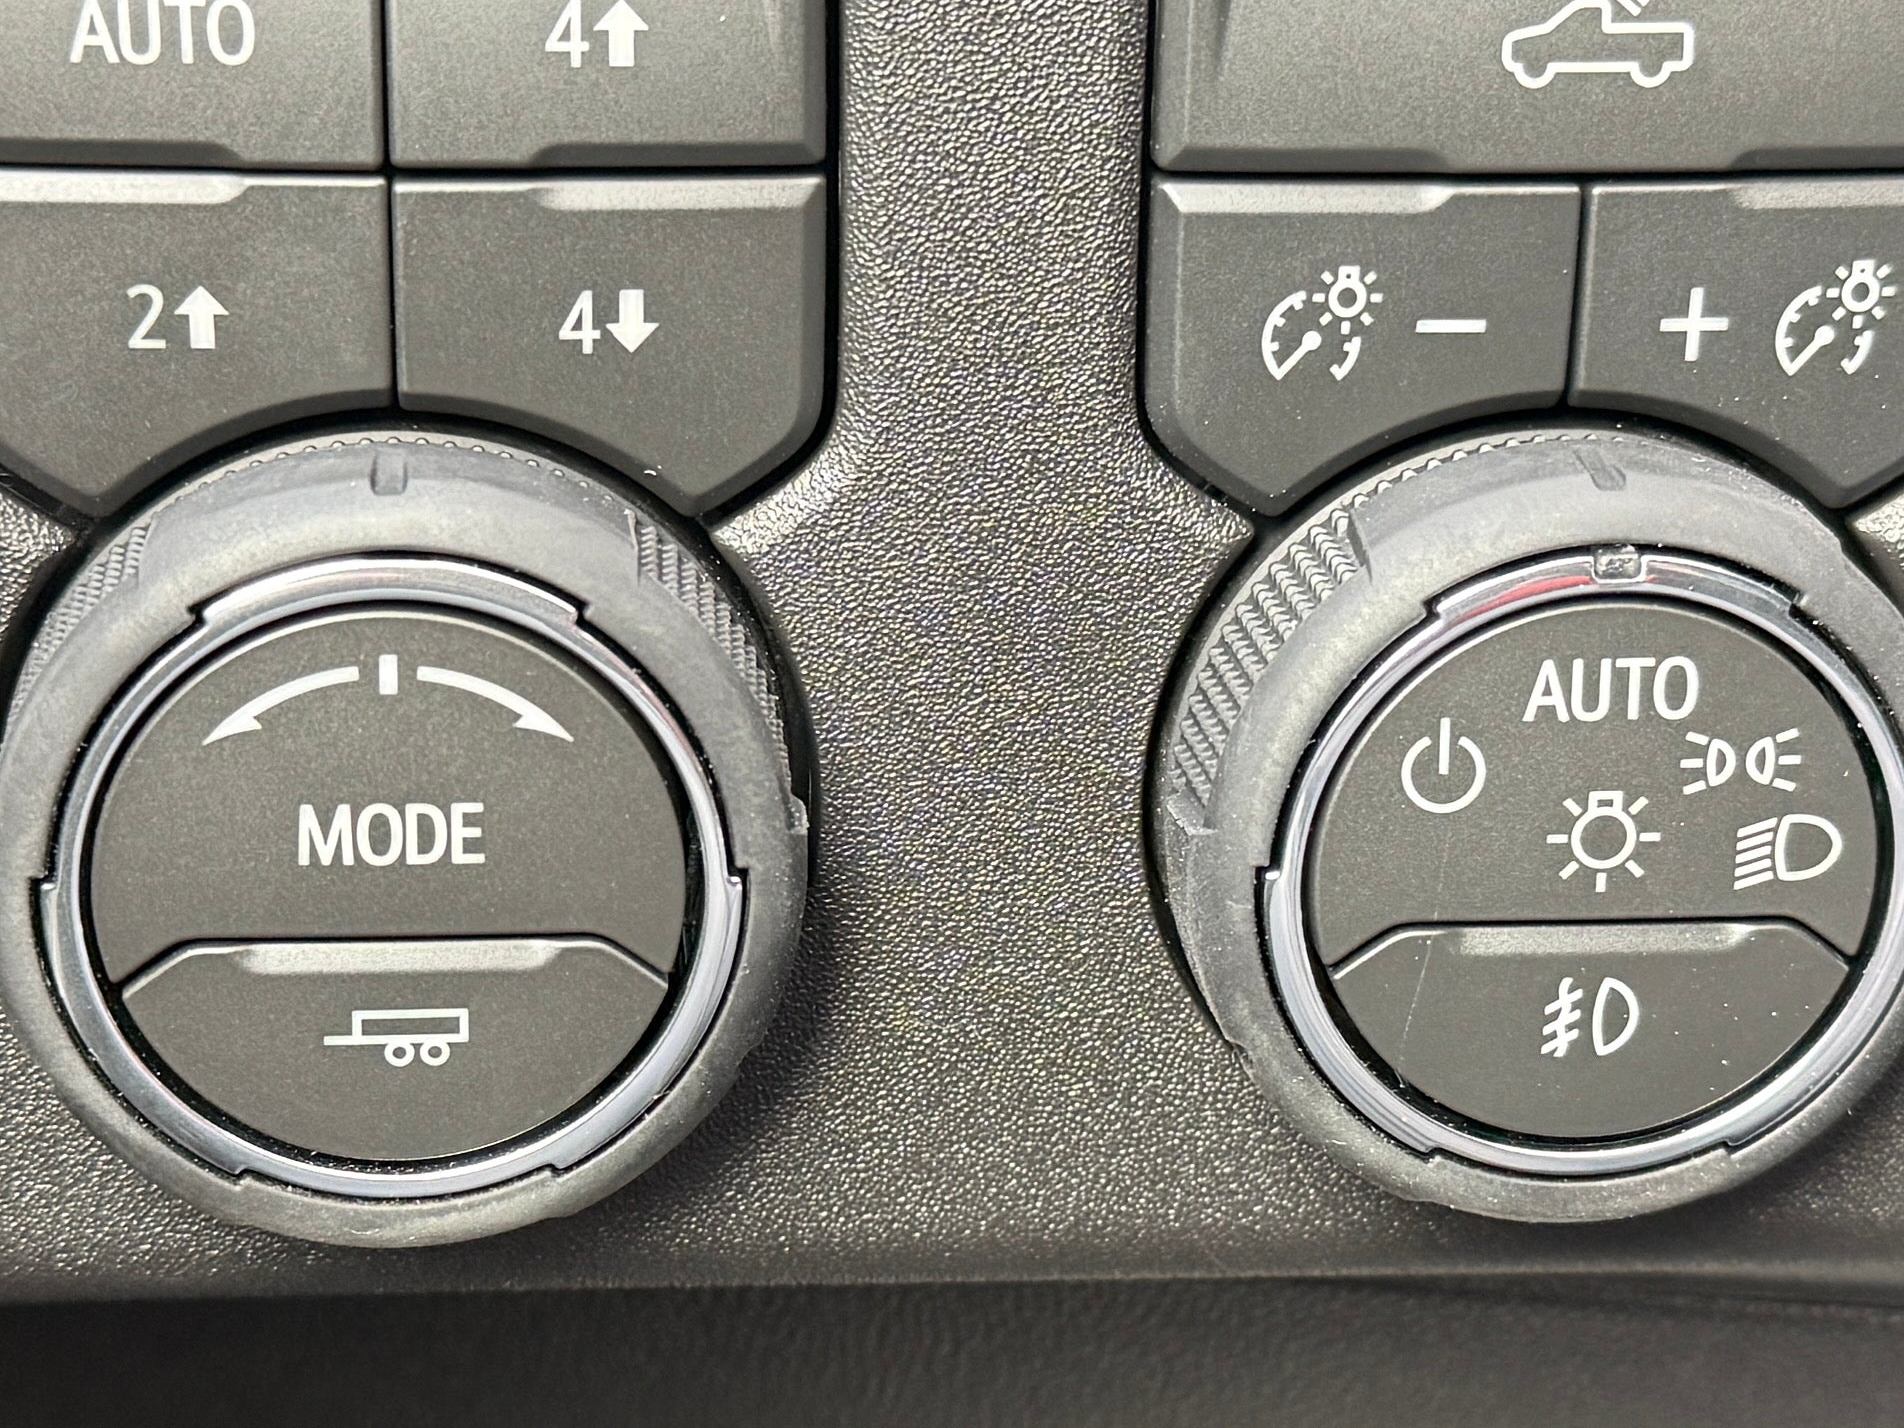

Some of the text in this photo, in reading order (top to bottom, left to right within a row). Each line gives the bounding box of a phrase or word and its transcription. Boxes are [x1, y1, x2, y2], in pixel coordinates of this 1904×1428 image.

[126, 283, 168, 349] 2
[558, 289, 601, 355] 4
[1521, 655, 1701, 723] AUTO
[297, 802, 486, 868] MODE
